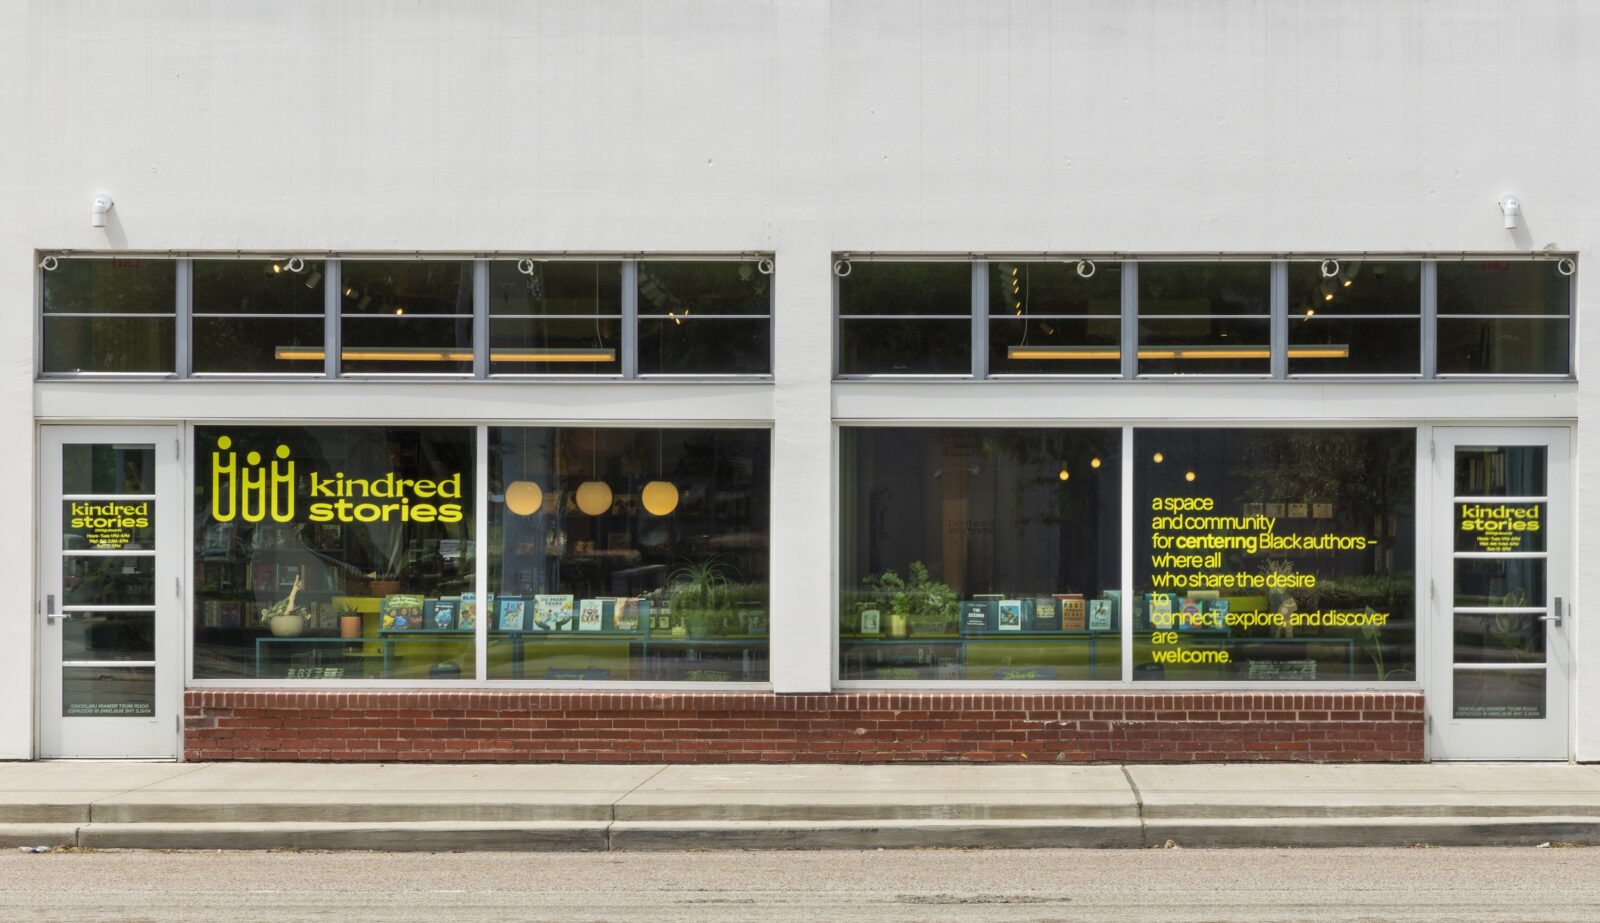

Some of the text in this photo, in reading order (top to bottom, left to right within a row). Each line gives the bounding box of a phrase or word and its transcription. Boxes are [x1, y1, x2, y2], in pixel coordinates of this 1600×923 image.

[309, 472, 462, 500] kindred
[71, 502, 148, 516] kindred
[307, 497, 464, 524] stories
[1152, 497, 1214, 514] a space
[1461, 504, 1539, 519] kindred
[70, 515, 149, 529] stories
[1152, 514, 1276, 535] and community
[1461, 517, 1540, 532] stories
[1152, 533, 1174, 549] for
[1176, 533, 1258, 553] centering
[1259, 533, 1303, 550] Black
[1303, 535, 1366, 550] authors
[1152, 552, 1222, 568] where all
[1152, 571, 1316, 588] who share the desire
[1152, 590, 1170, 607] to
[1224, 609, 1287, 629] explore,
[1289, 609, 1321, 626] and
[1321, 609, 1390, 626] discover
[1152, 630, 1179, 645] are
[1152, 647, 1233, 664] welcome.
